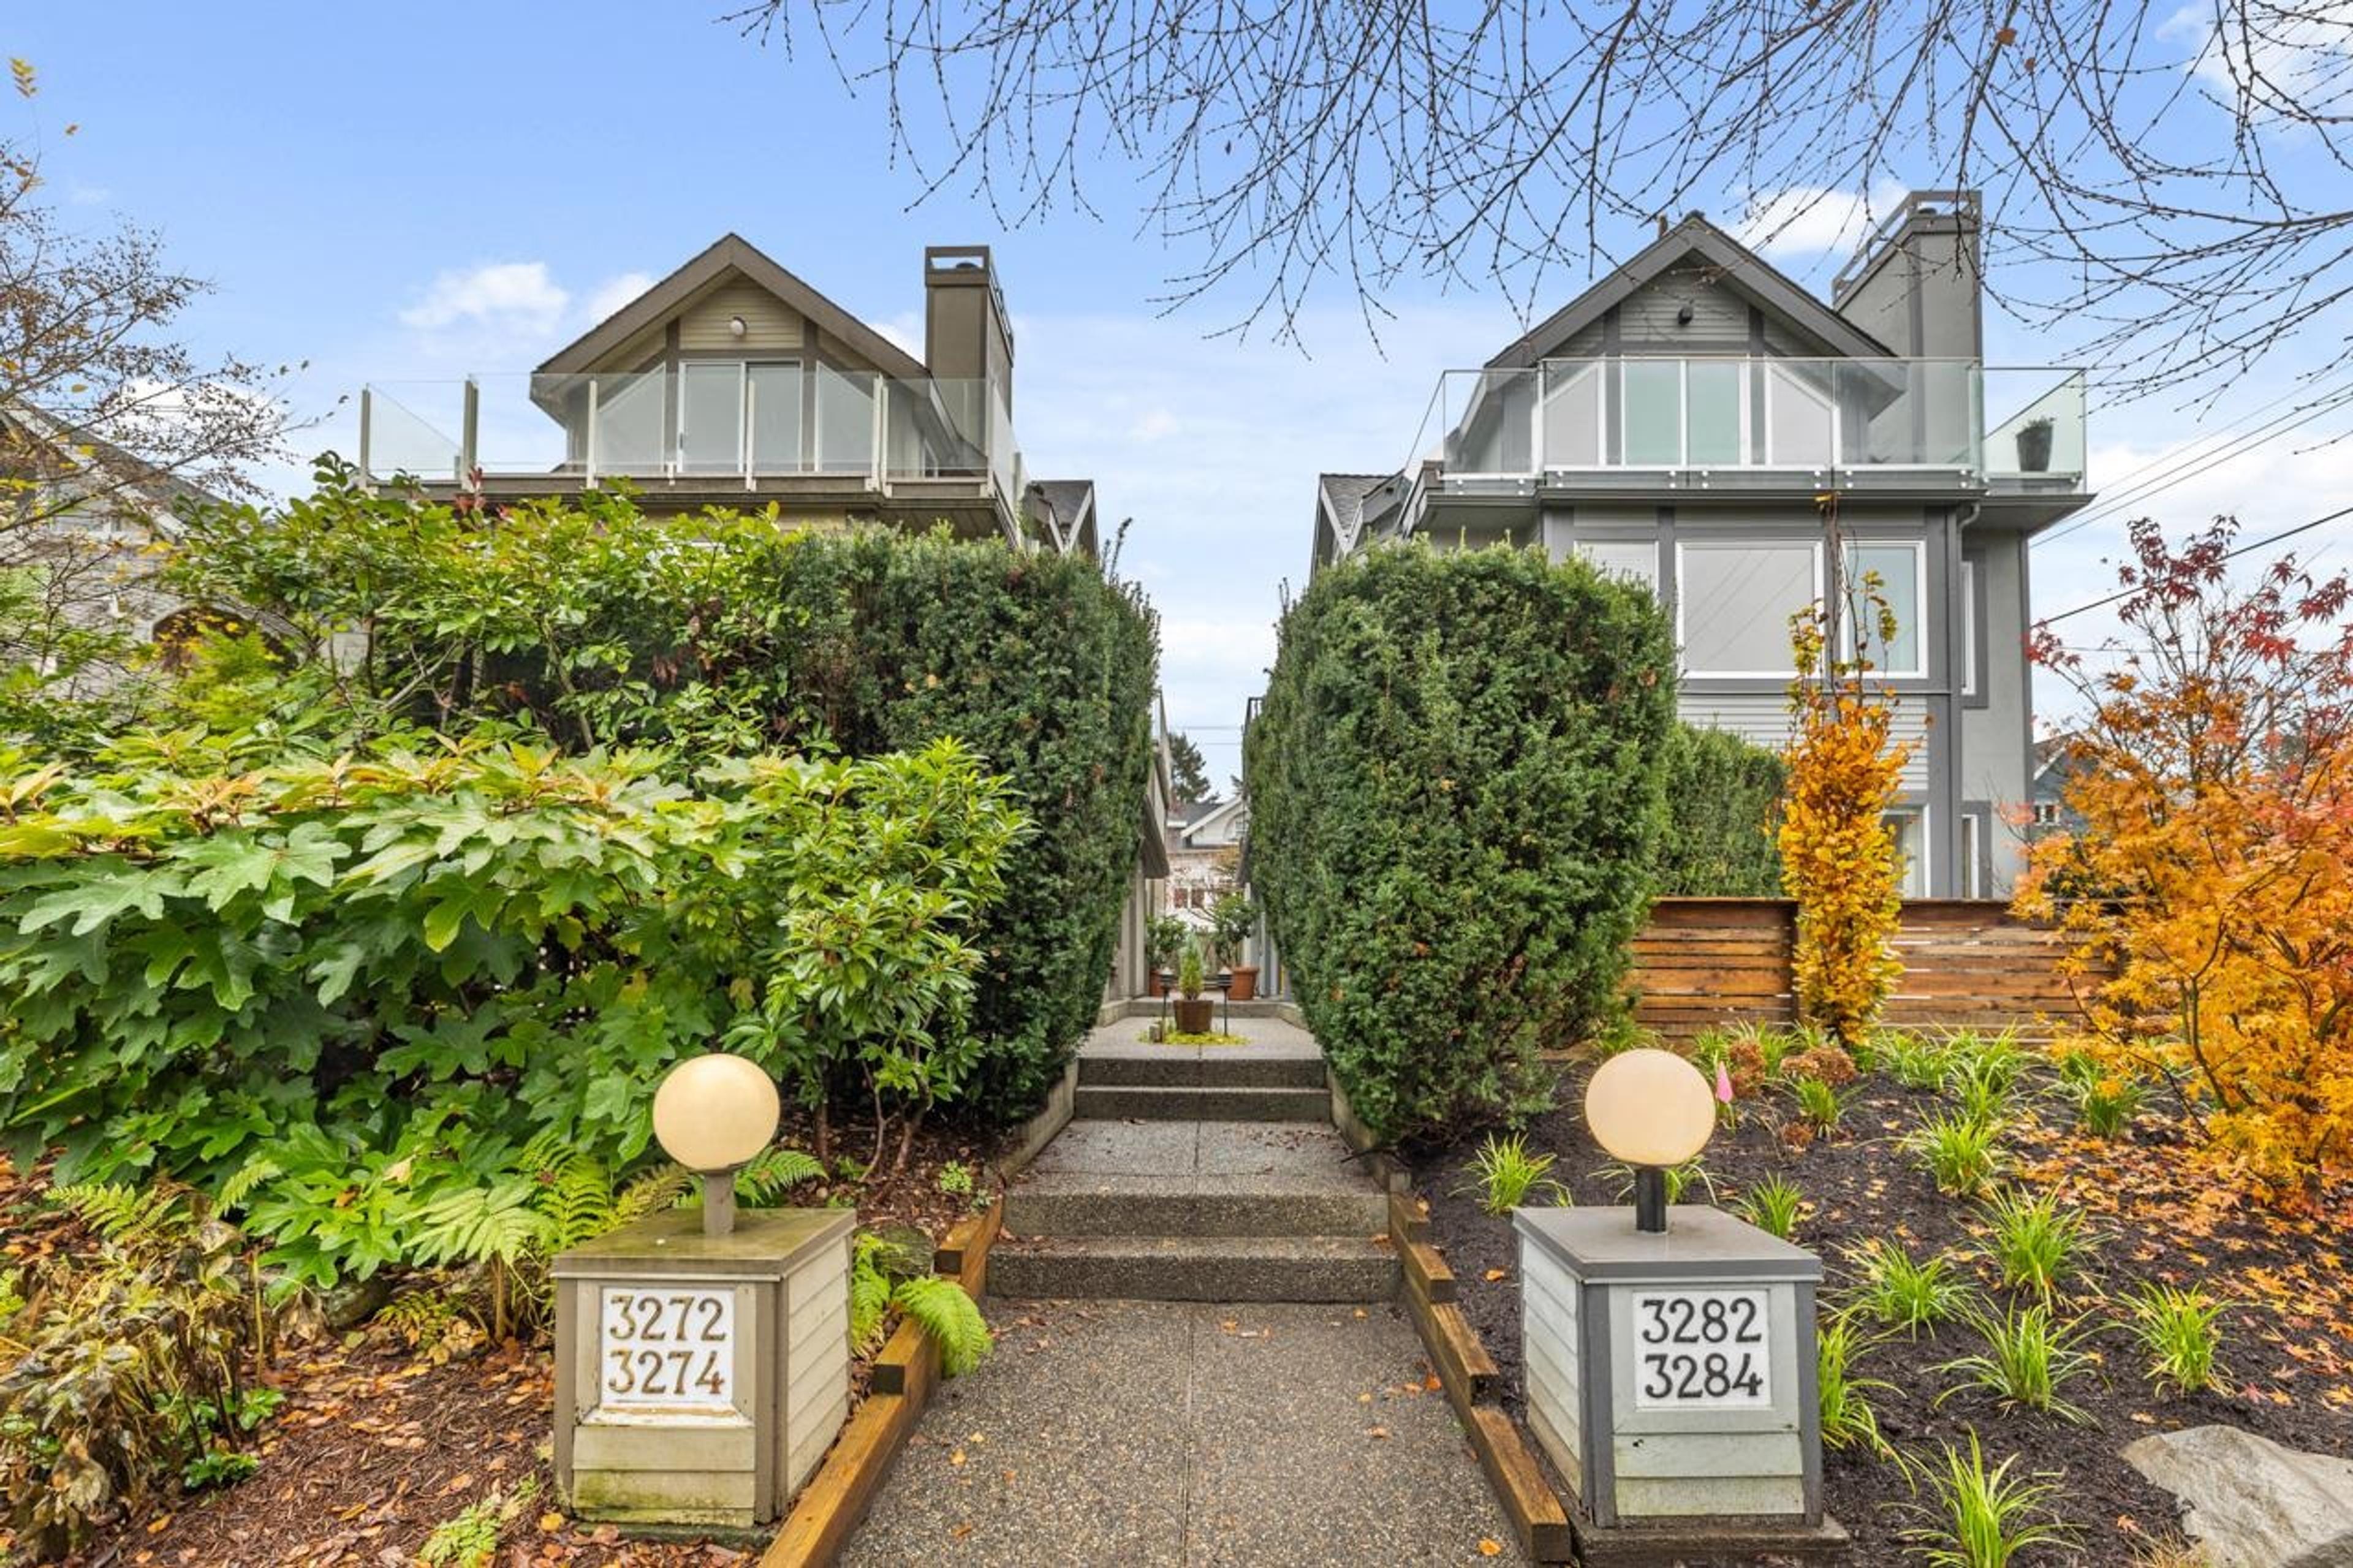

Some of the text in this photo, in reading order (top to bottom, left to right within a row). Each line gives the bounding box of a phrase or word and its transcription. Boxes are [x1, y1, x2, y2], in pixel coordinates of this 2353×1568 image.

[610, 1295, 726, 1342] 3272
[1642, 1297, 1762, 1344] 3282
[608, 1349, 726, 1396] 3274
[1645, 1352, 1764, 1399] 3284
